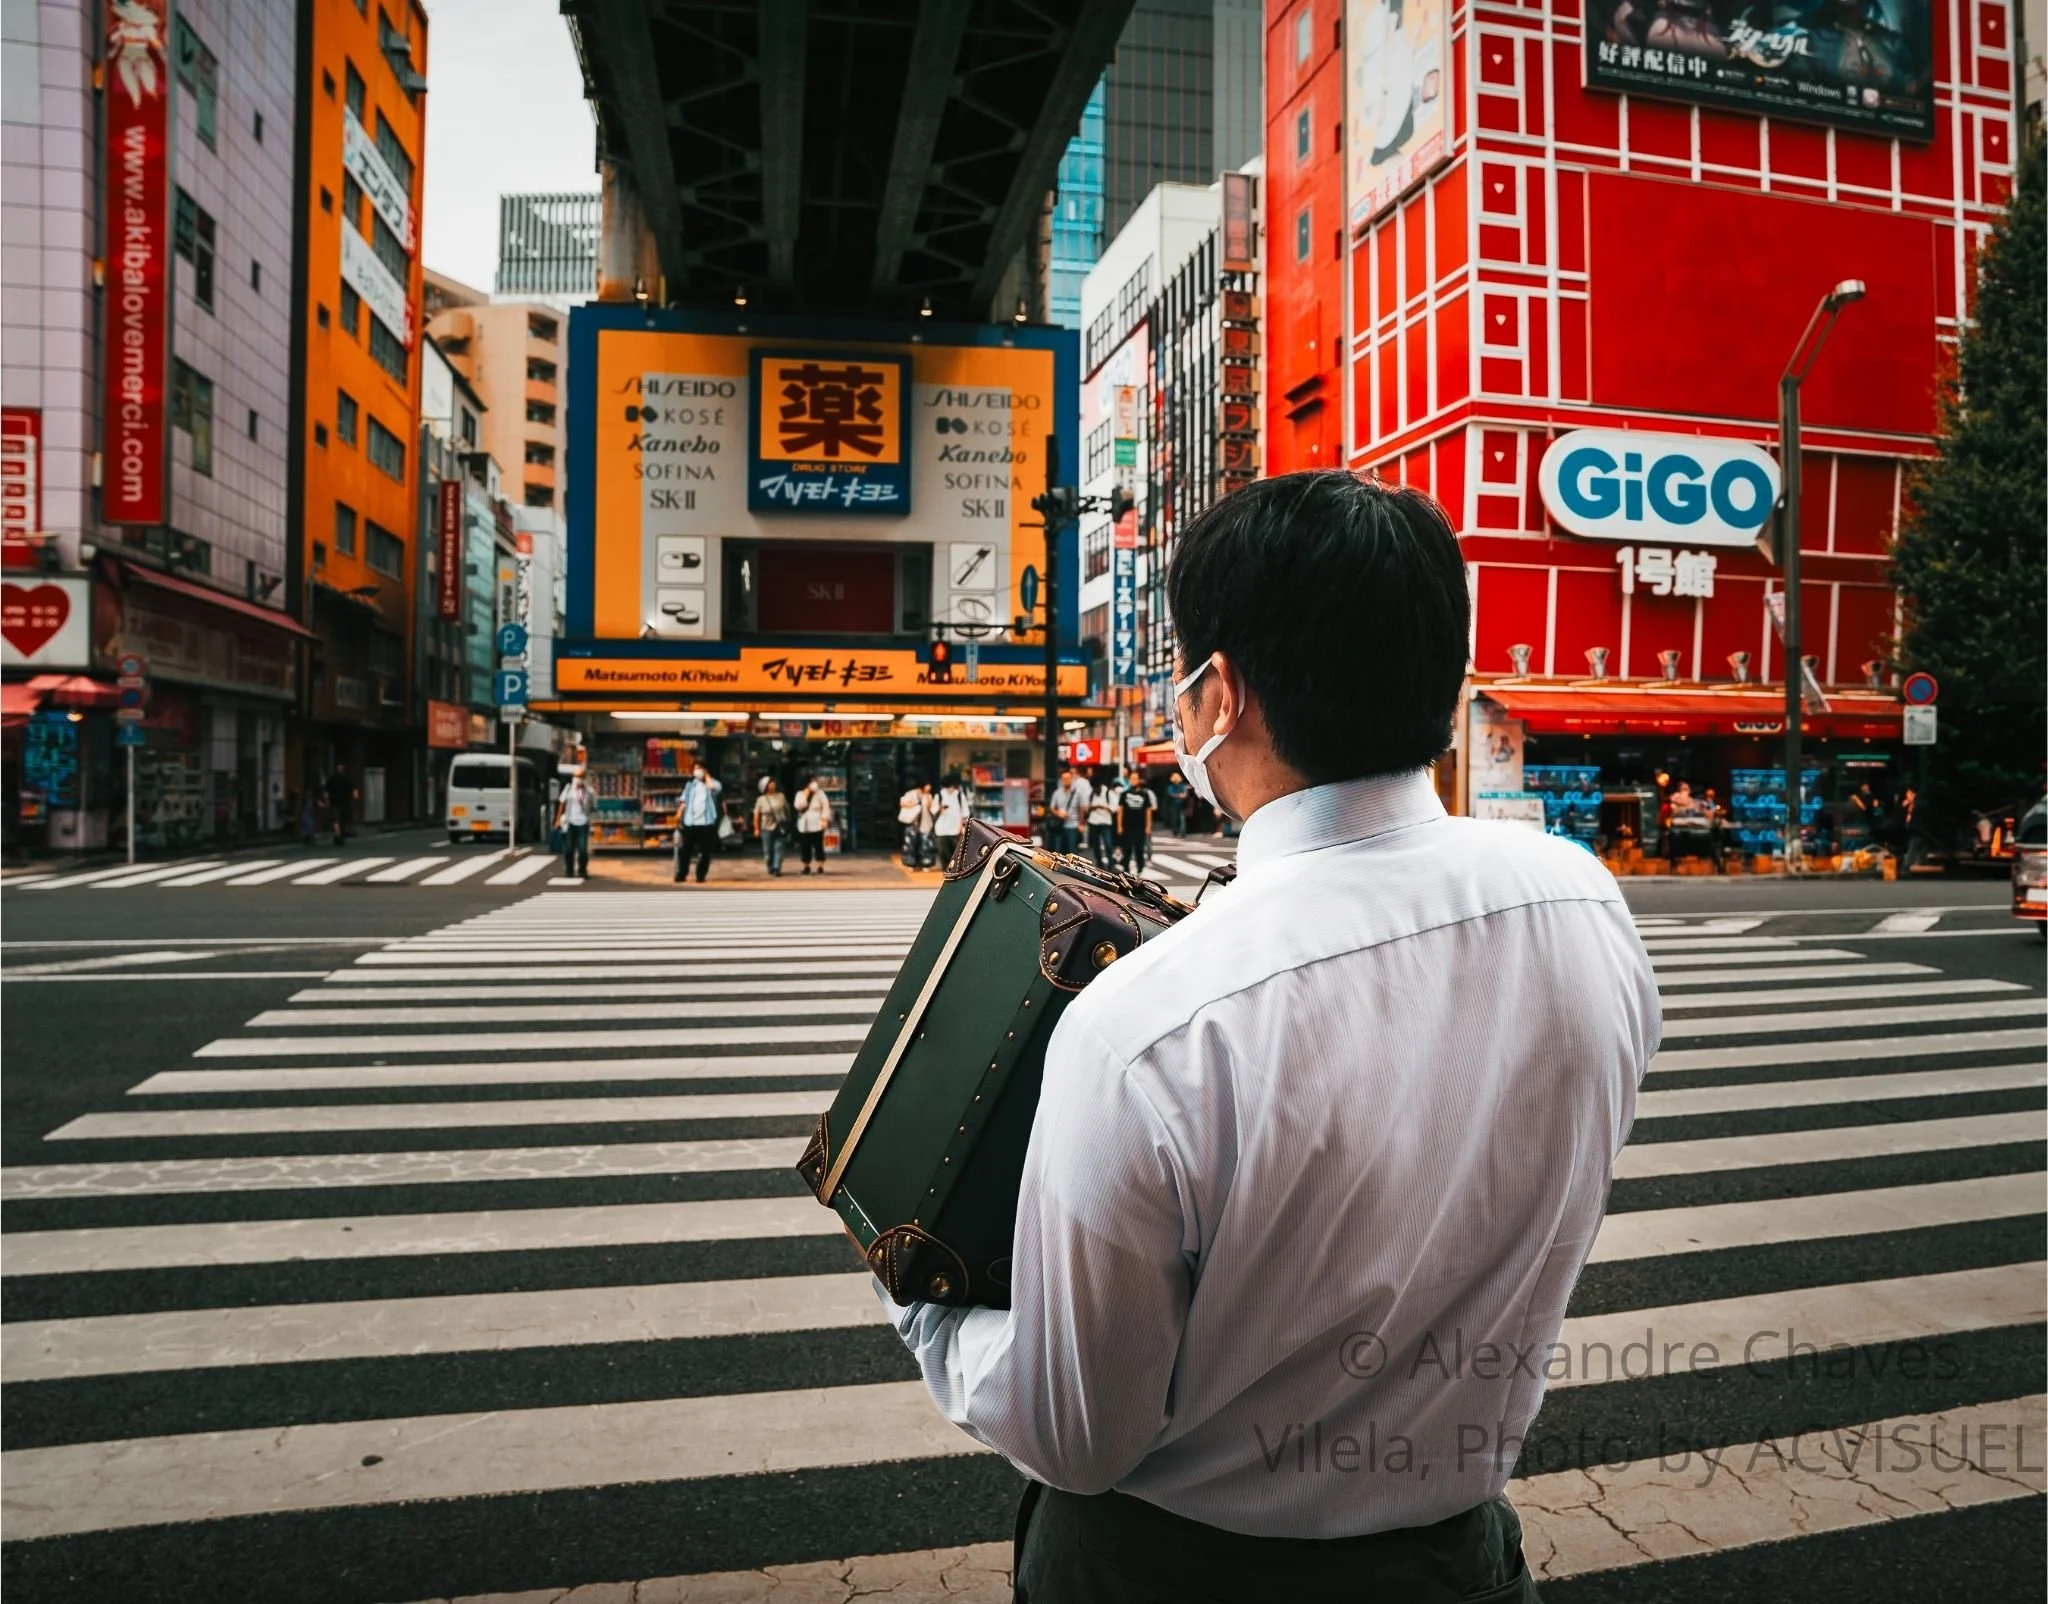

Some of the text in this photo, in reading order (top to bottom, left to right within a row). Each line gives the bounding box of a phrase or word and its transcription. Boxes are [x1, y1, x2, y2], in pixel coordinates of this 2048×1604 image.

[1598, 40, 1708, 78] 好評配信中
[1797, 80, 1842, 99] Windows
[122, 125, 152, 502] www.akibalovemerci.com
[612, 376, 737, 399] SHISEIDO
[778, 363, 885, 457] 薬
[923, 389, 1041, 410] SHISEIDO
[664, 406, 725, 426] KOSÉ
[973, 418, 1031, 437] KOSÉ
[627, 433, 721, 454] Kanebo
[938, 444, 1027, 464] Kanebo
[632, 462, 715, 481] SOFINA
[791, 462, 868, 475] DRUG STORE
[759, 474, 899, 507] マツモトキヨシ
[944, 472, 1023, 490] SOFINA
[1558, 447, 1774, 530] GiGO
[1616, 546, 1718, 598] 1号館
[503, 630, 516, 650] P
[584, 668, 739, 683] Matsumoto KiYoshi
[762, 657, 893, 687] マツモトキヨシ
[504, 674, 521, 701] P
